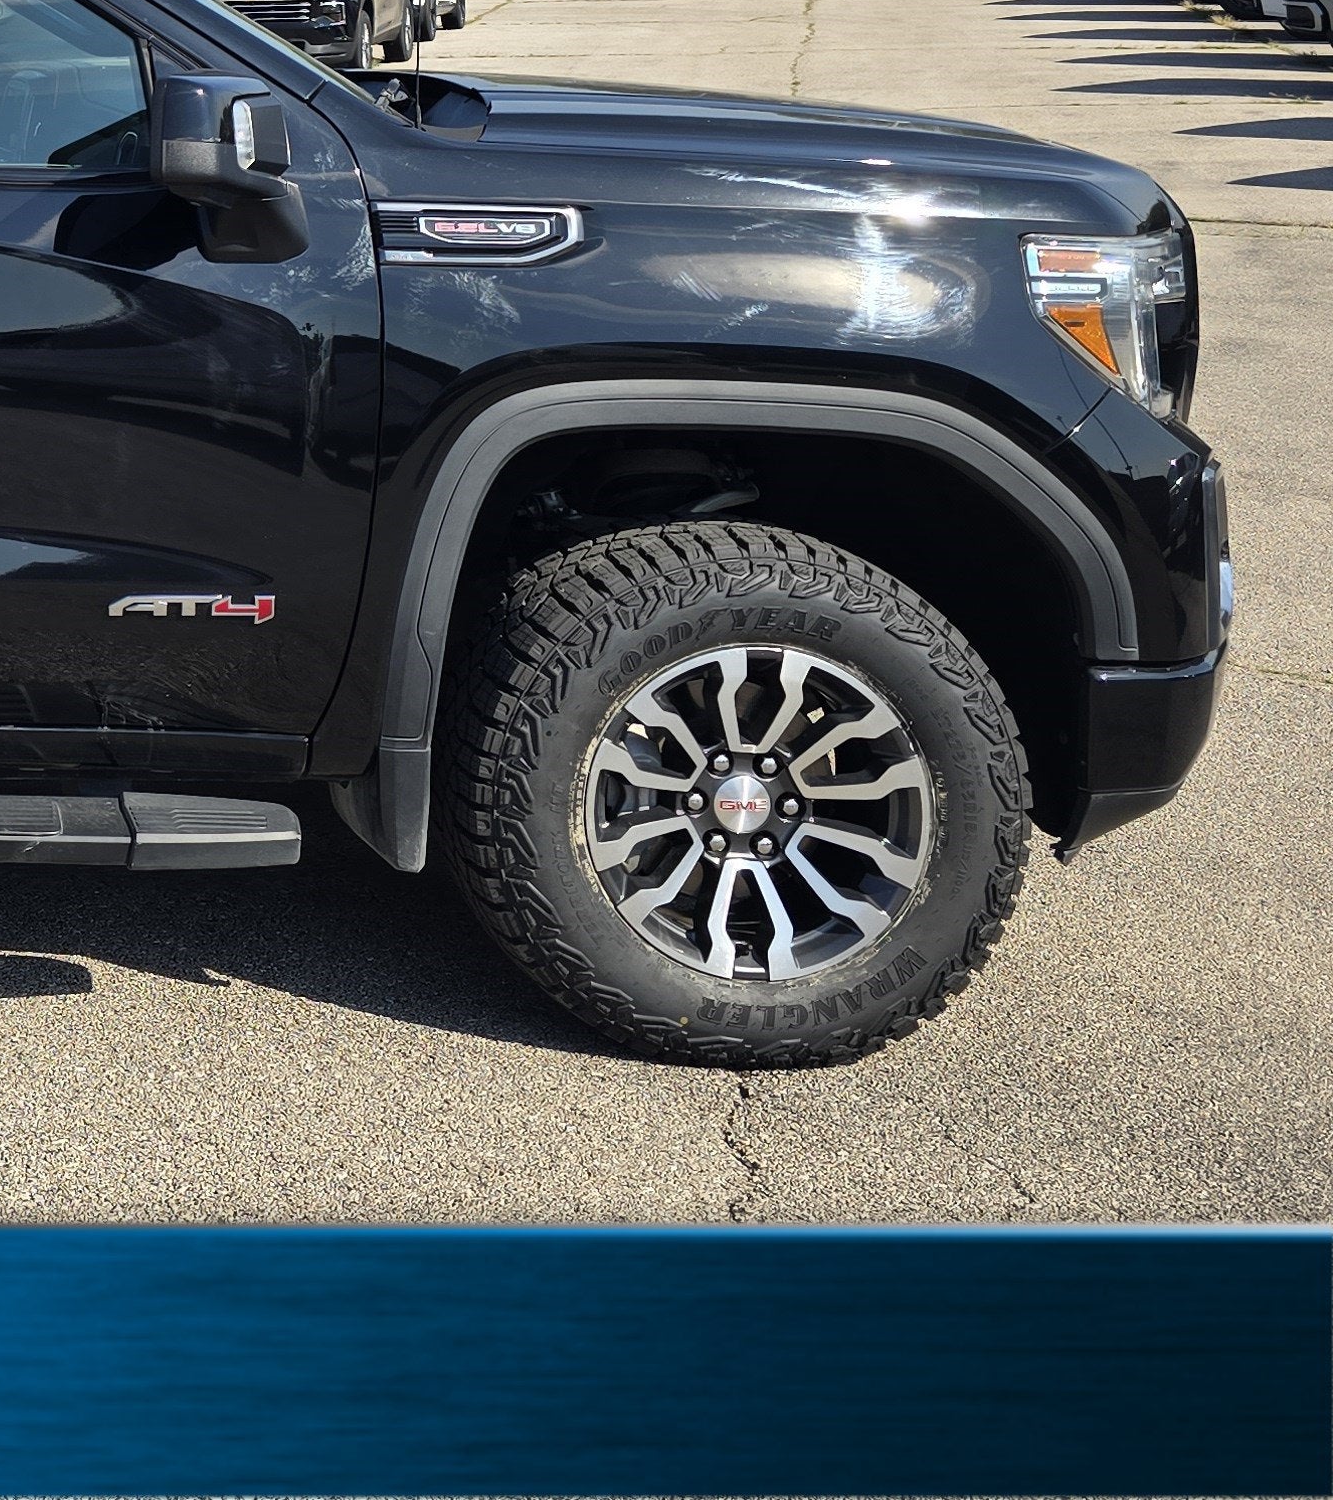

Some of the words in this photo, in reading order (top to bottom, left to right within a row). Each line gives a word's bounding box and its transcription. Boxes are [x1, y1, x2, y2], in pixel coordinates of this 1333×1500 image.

[108, 595, 276, 624] AT4
[597, 605, 842, 697] GOODYEAR
[719, 799, 768, 811] GMC
[695, 944, 930, 1030] WRANGLER
